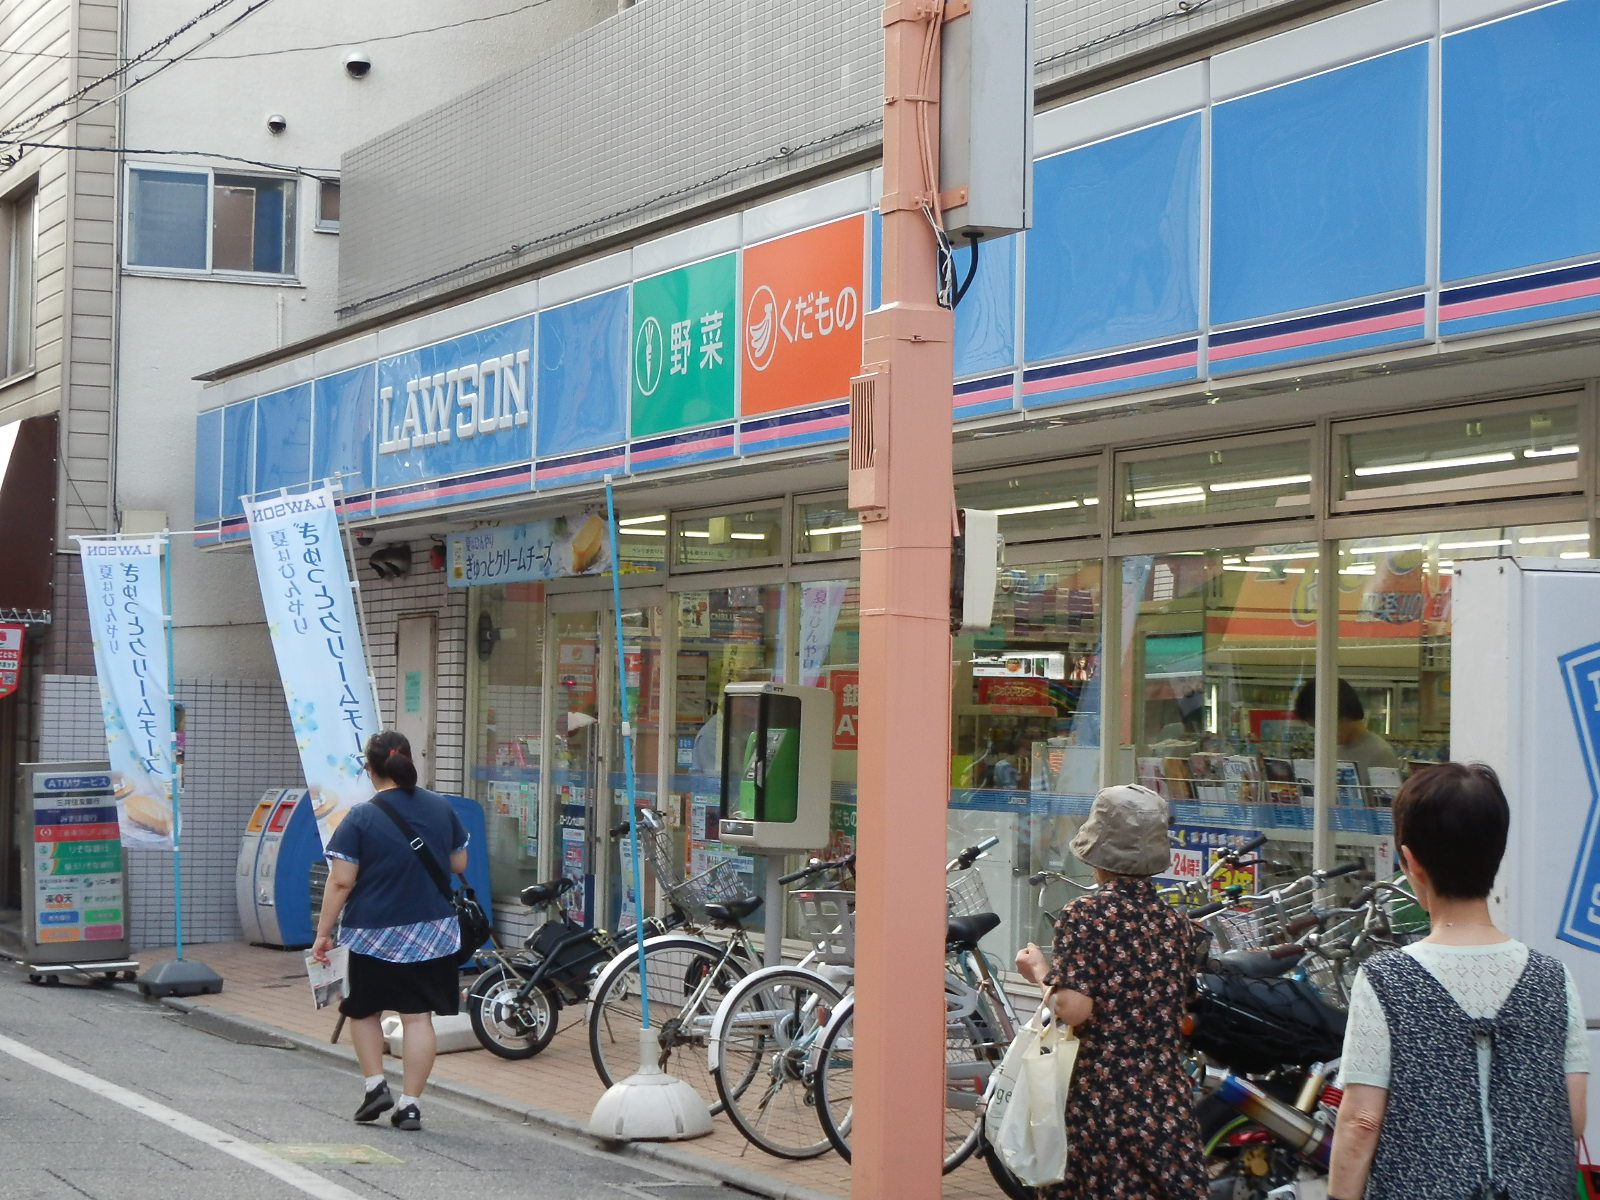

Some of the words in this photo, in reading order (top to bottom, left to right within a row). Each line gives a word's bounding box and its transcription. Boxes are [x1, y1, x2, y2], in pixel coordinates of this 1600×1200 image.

[669, 310, 724, 377] 野菜
[778, 285, 859, 344] くだもの
[378, 347, 530, 455] LAWSON
[465, 540, 554, 581] ぎゅっとクリームチーズ
